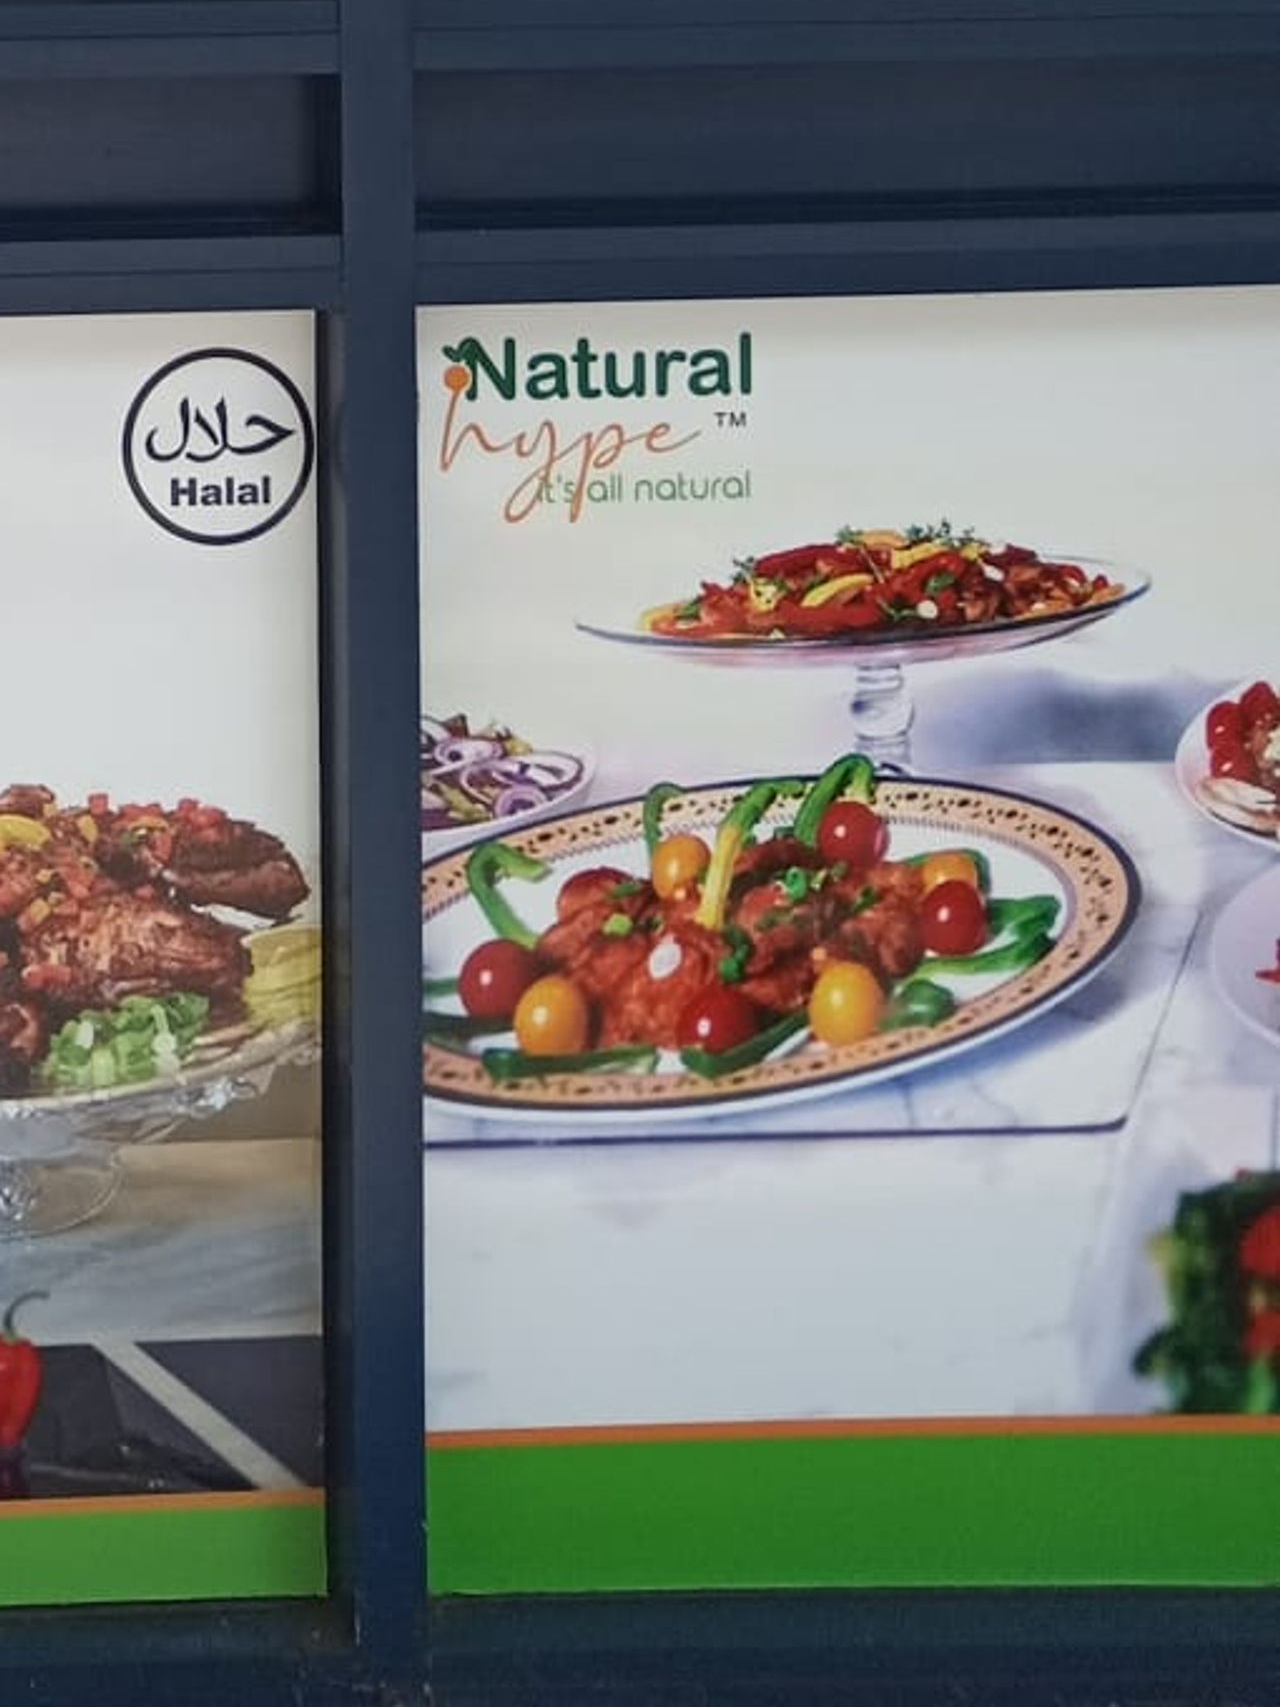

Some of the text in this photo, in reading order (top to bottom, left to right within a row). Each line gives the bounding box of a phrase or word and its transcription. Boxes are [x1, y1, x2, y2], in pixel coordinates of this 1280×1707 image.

[457, 331, 753, 402] Natural
[145, 395, 297, 463] حلال
[169, 474, 272, 507] Halal
[586, 473, 624, 503] all
[633, 470, 752, 503] natural
